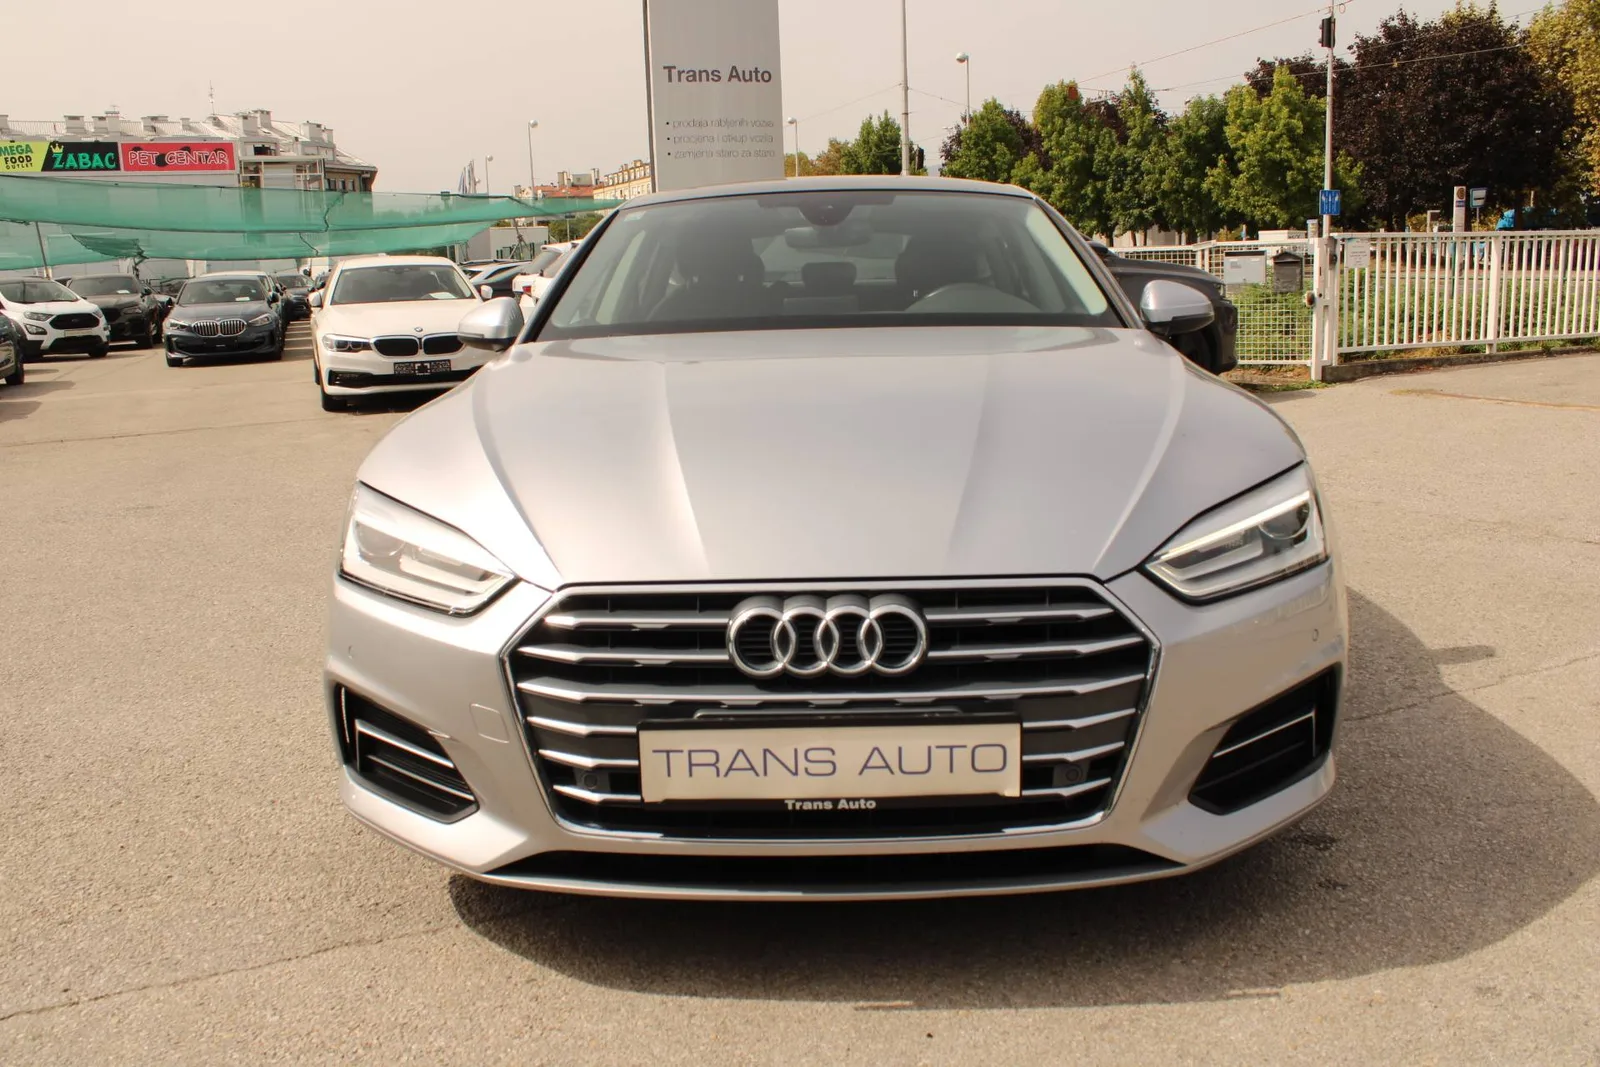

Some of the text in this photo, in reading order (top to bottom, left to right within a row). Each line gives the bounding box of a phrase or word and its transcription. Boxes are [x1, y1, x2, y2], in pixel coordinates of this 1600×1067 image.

[663, 65, 772, 83] Trans Auto
[673, 118, 708, 129] prodaja
[750, 134, 774, 143] vozila
[0, 144, 33, 156] MEGA
[4, 155, 32, 165] FOOD
[129, 150, 229, 166] PET CENTAR
[652, 743, 1008, 778] TRANS AUTO
[784, 798, 877, 810] Trans Auto
